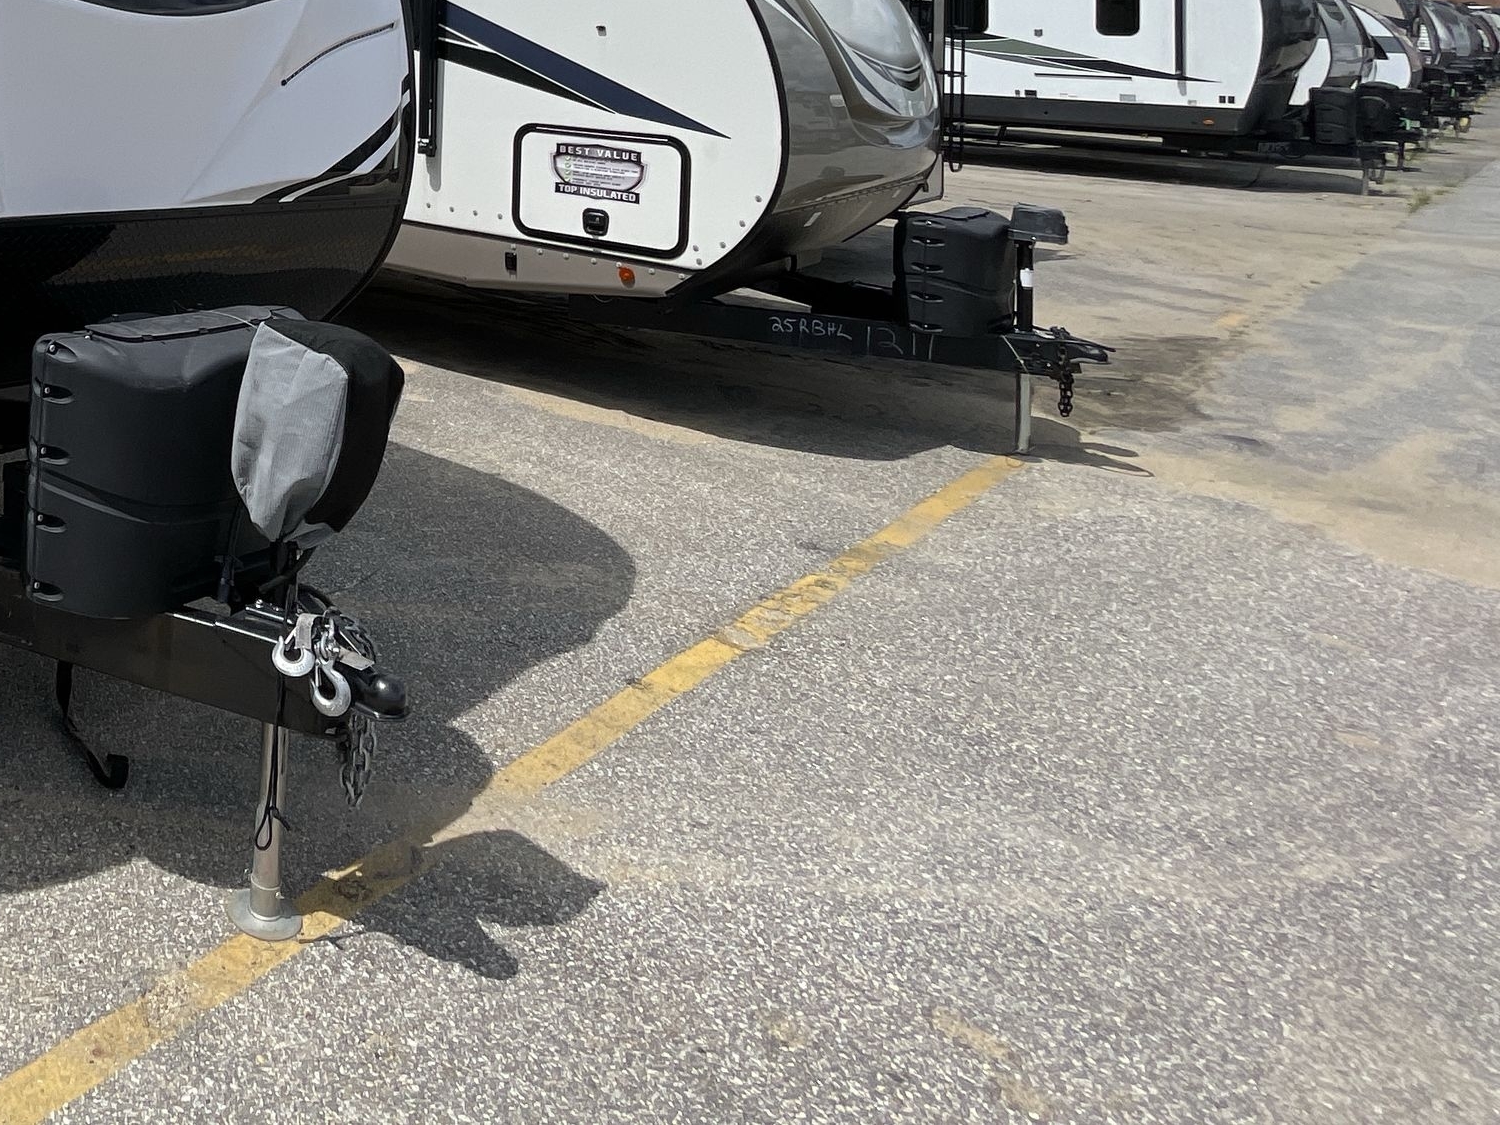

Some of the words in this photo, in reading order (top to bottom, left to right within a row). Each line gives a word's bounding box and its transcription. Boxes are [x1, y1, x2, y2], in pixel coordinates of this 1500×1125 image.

[559, 145, 590, 155] BEST
[597, 149, 638, 161] VALUE
[558, 184, 578, 193] TOP
[579, 187, 637, 202] INSULATED
